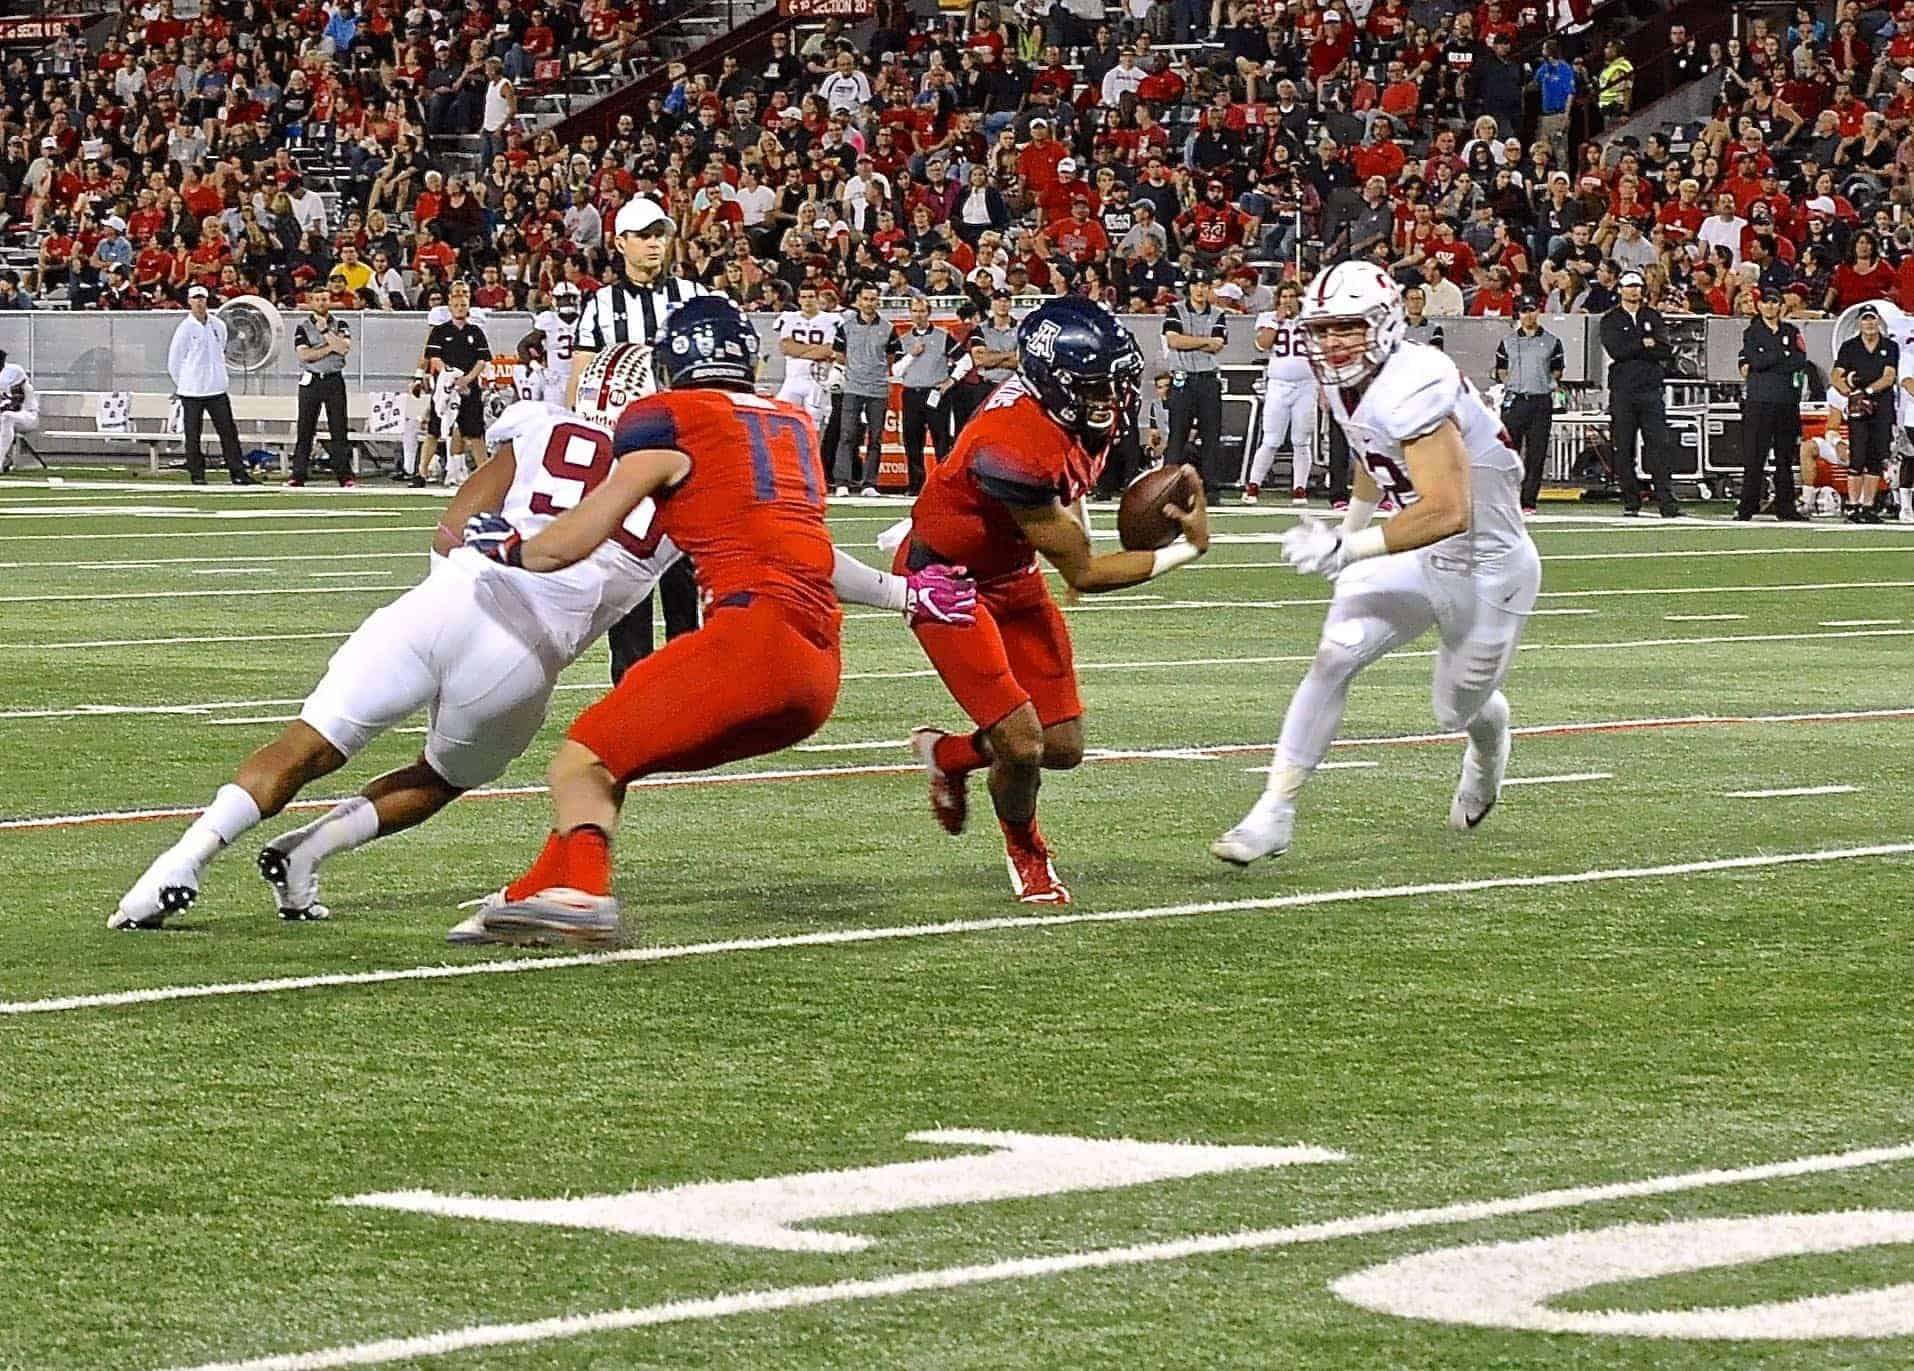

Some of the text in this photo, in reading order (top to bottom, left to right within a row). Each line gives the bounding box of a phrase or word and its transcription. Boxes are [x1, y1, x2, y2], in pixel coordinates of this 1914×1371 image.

[557, 334, 574, 360] 3
[1026, 319, 1062, 362] A
[1275, 328, 1311, 358] 92
[733, 409, 820, 504] 17
